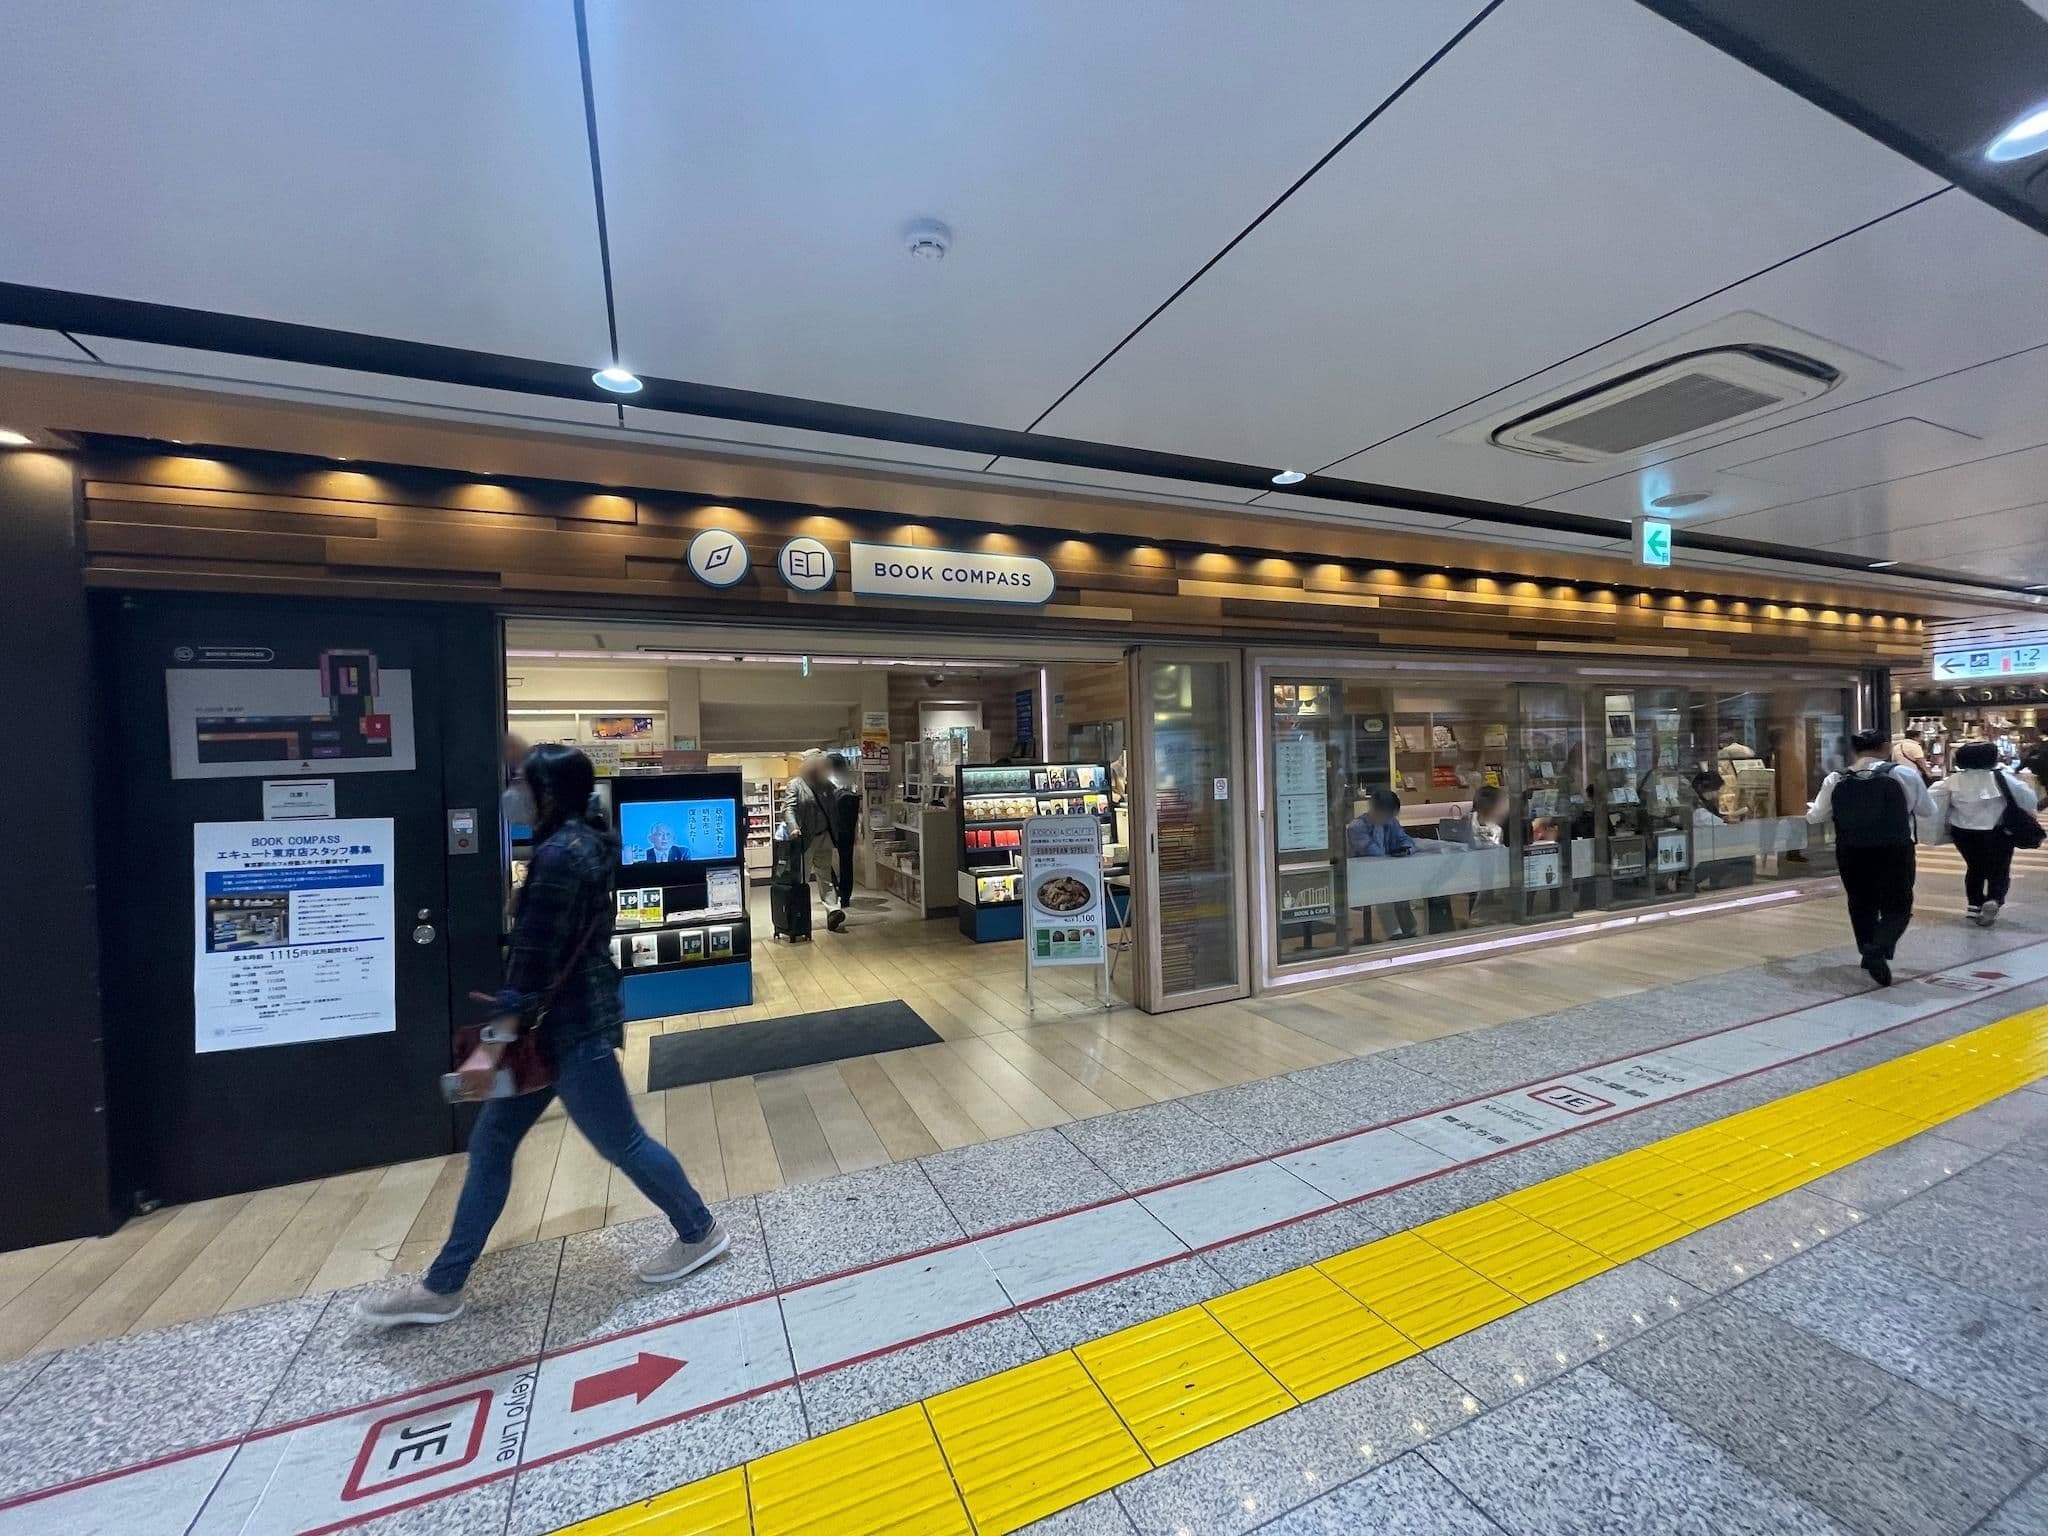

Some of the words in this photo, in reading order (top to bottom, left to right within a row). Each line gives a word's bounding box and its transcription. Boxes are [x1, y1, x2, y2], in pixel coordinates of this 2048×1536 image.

[874, 562, 934, 581] BOOK
[942, 568, 1032, 587] COMPASS
[251, 836, 283, 847] BOOK
[288, 835, 341, 845] COMPASS
[217, 845, 373, 860] エキュート東京店スタッフ募集
[1624, 1070, 1665, 1085] Line
[1549, 1094, 1593, 1108] JE
[1481, 1104, 1544, 1131] Maihama
[388, 1422, 452, 1470] JE
[496, 1419, 526, 1462] Line
